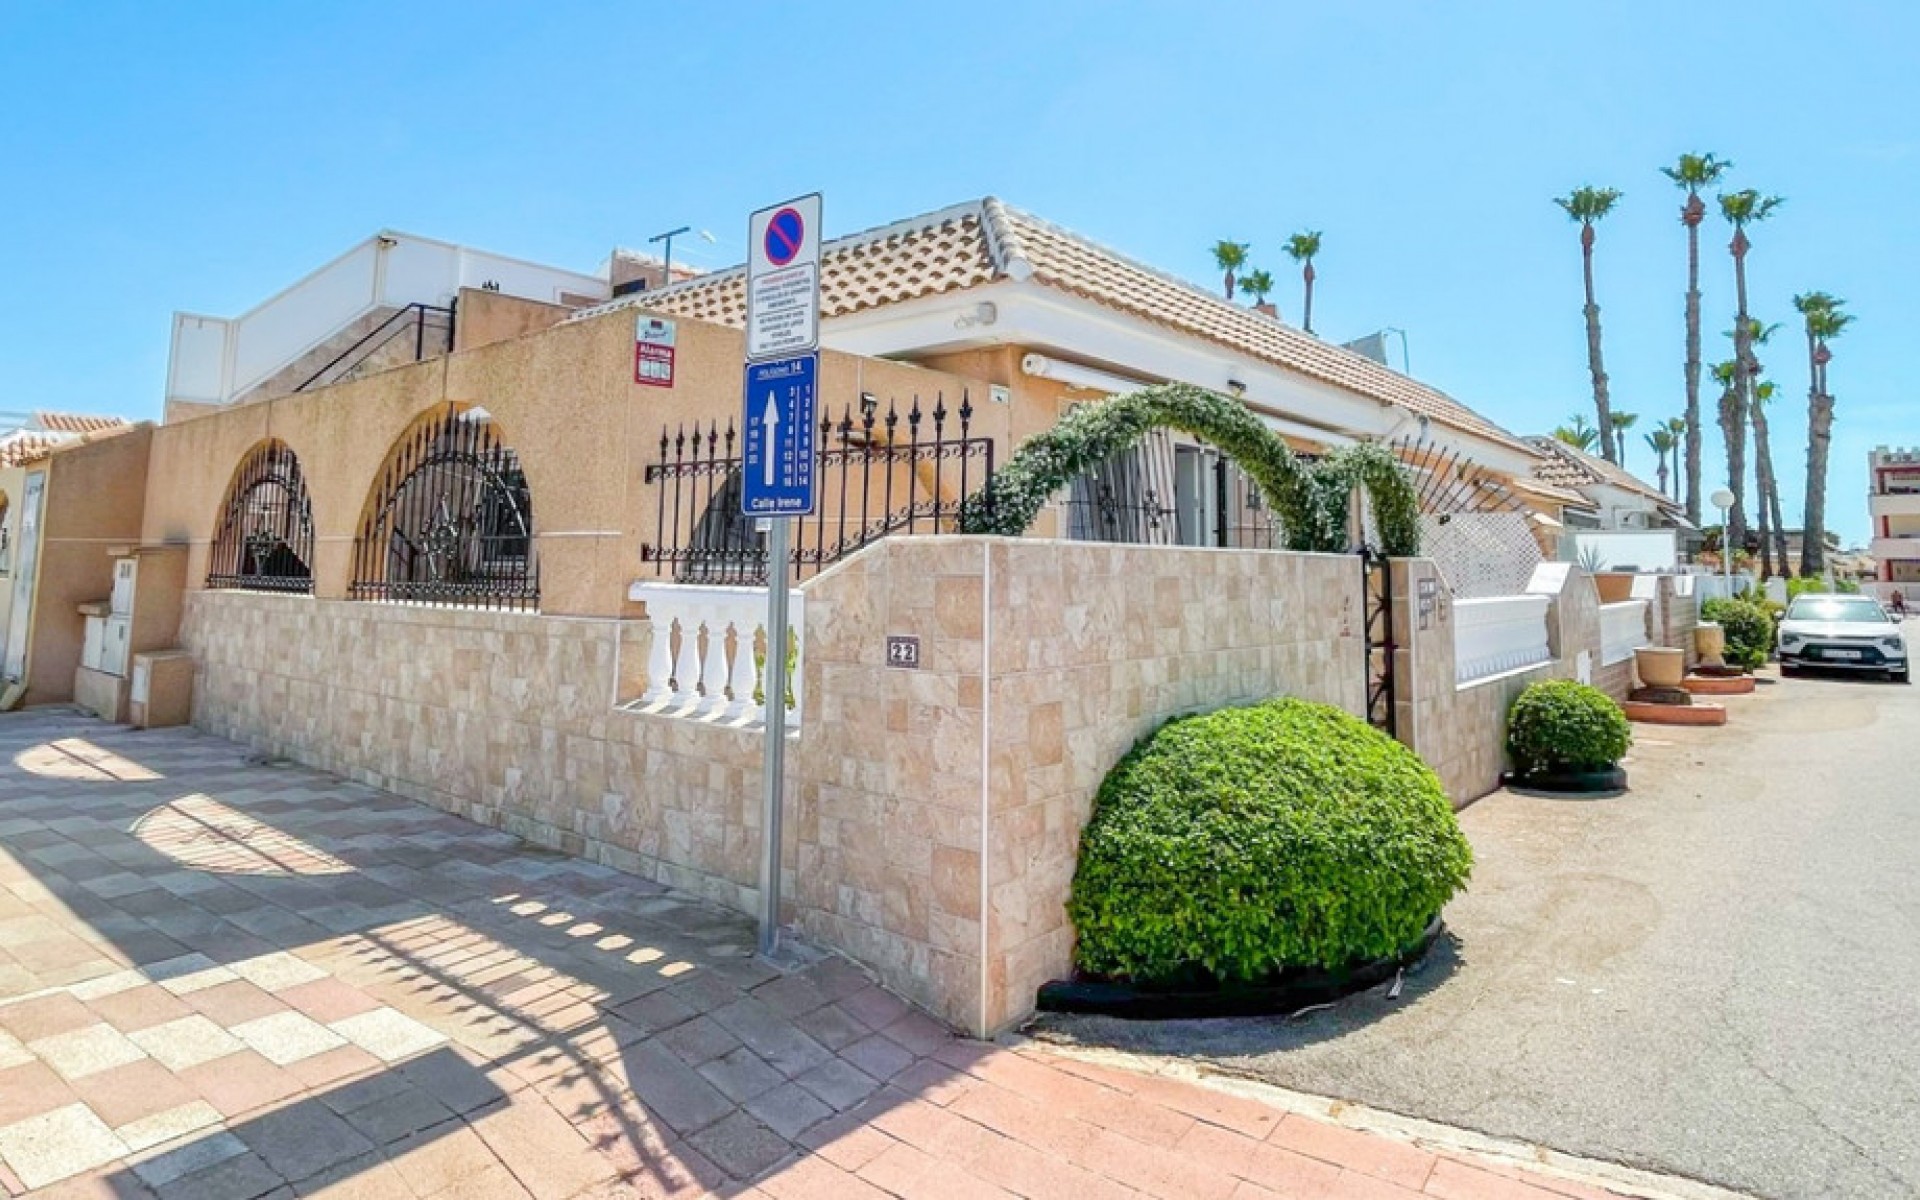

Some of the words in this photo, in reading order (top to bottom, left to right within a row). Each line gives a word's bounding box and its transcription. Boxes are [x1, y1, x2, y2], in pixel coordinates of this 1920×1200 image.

[751, 497, 775, 509] Calle
[777, 497, 802, 508] Irene
[892, 643, 914, 661] 22
